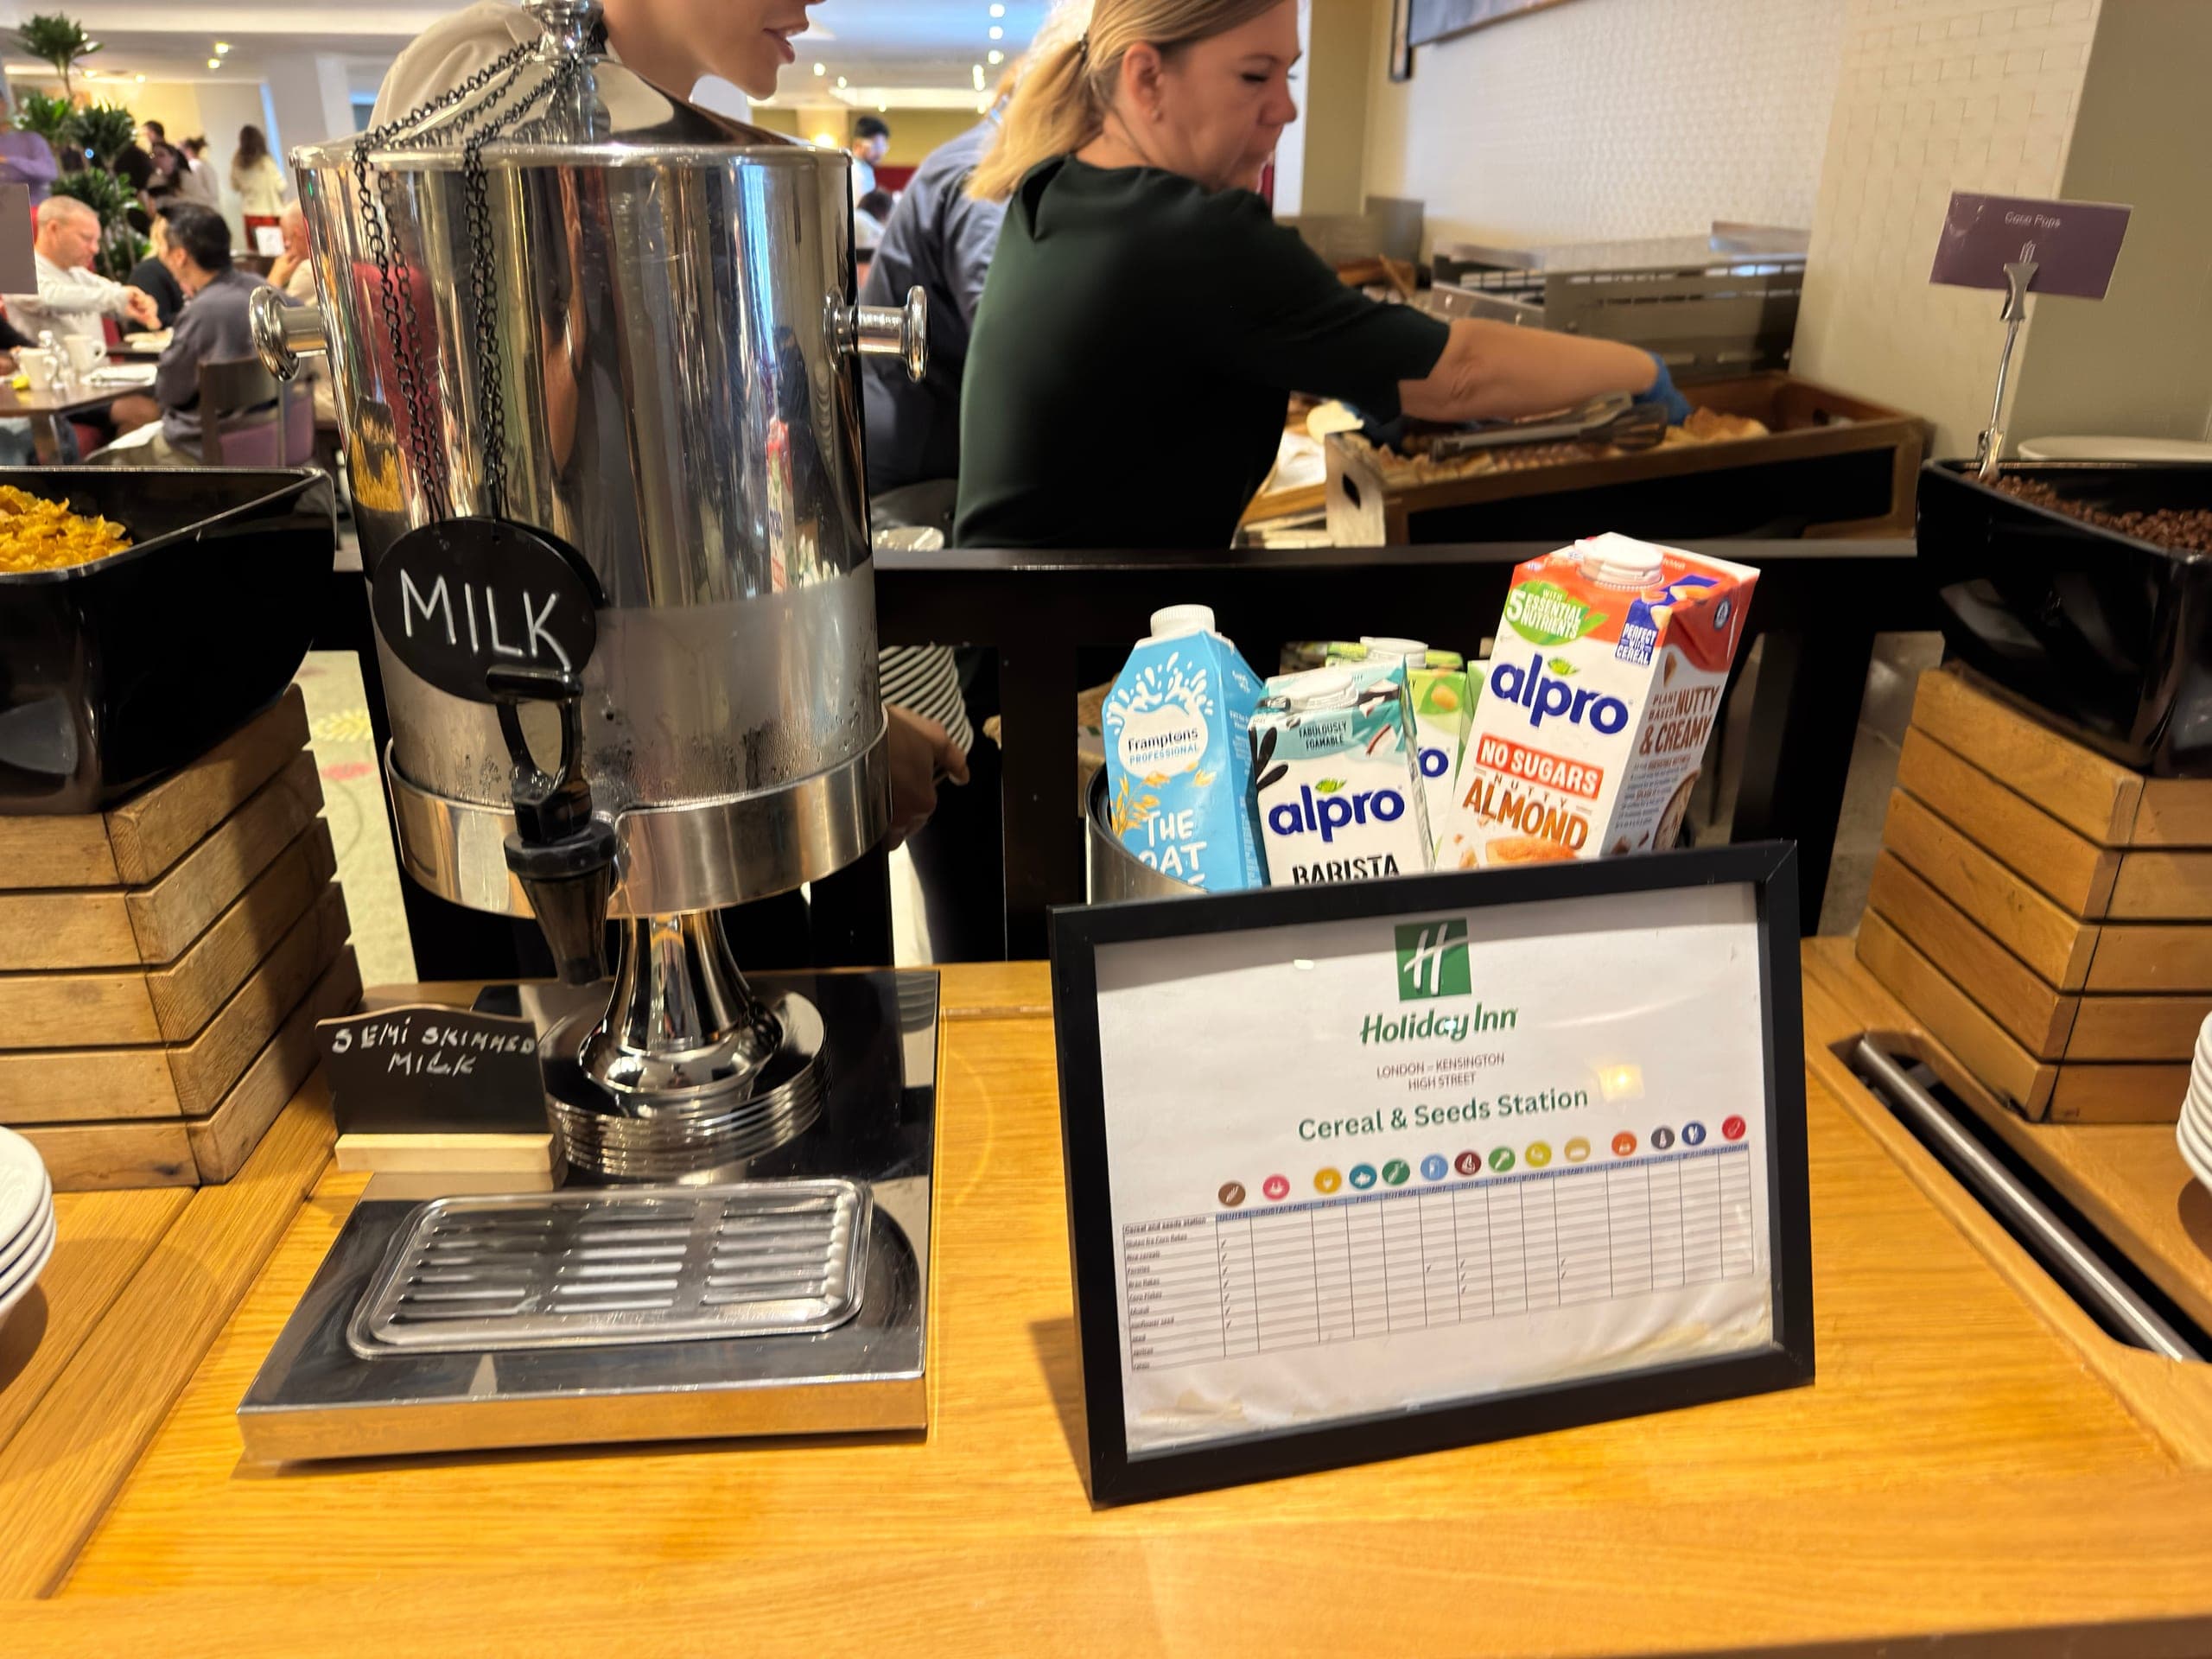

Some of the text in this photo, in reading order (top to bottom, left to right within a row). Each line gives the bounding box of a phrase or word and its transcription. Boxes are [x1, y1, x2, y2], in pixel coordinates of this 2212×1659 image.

[1506, 588, 1582, 623] 5 ESSENTIAL
[1542, 588, 1564, 602] WITH
[398, 567, 573, 672] MILK
[1521, 608, 1581, 639] NUTRIENTS
[1622, 622, 1657, 646] PERFECT
[1615, 645, 1650, 666] CEREAL
[1629, 638, 1646, 653] WITH
[1491, 652, 1630, 734] alpro
[1675, 685, 1720, 716] NUTTY
[1128, 726, 1199, 751] Framptons
[1299, 721, 1348, 739] FABULOUSLY
[1306, 735, 1344, 751] FOAMABLE
[1639, 715, 1713, 756] & CREAMY
[1129, 744, 1199, 764] PROFESSIONAL
[1480, 739, 1510, 770] NO
[1510, 748, 1599, 796] SUGARS
[1493, 772, 1568, 809] NUTTY
[1141, 809, 1194, 848] THE
[1268, 785, 1404, 842] alpro
[1462, 777, 1590, 851] ALMOND
[1293, 854, 1400, 885] BARISTA
[421, 1025, 536, 1056] SKIMMED
[387, 1052, 477, 1077] MILK
[1376, 1060, 1425, 1079] LONDON
[1435, 1052, 1505, 1073] KENSINGTON
[1408, 1072, 1477, 1091] HIGH STREET
[1298, 1088, 1588, 1141] Cereal & Seeds Station
